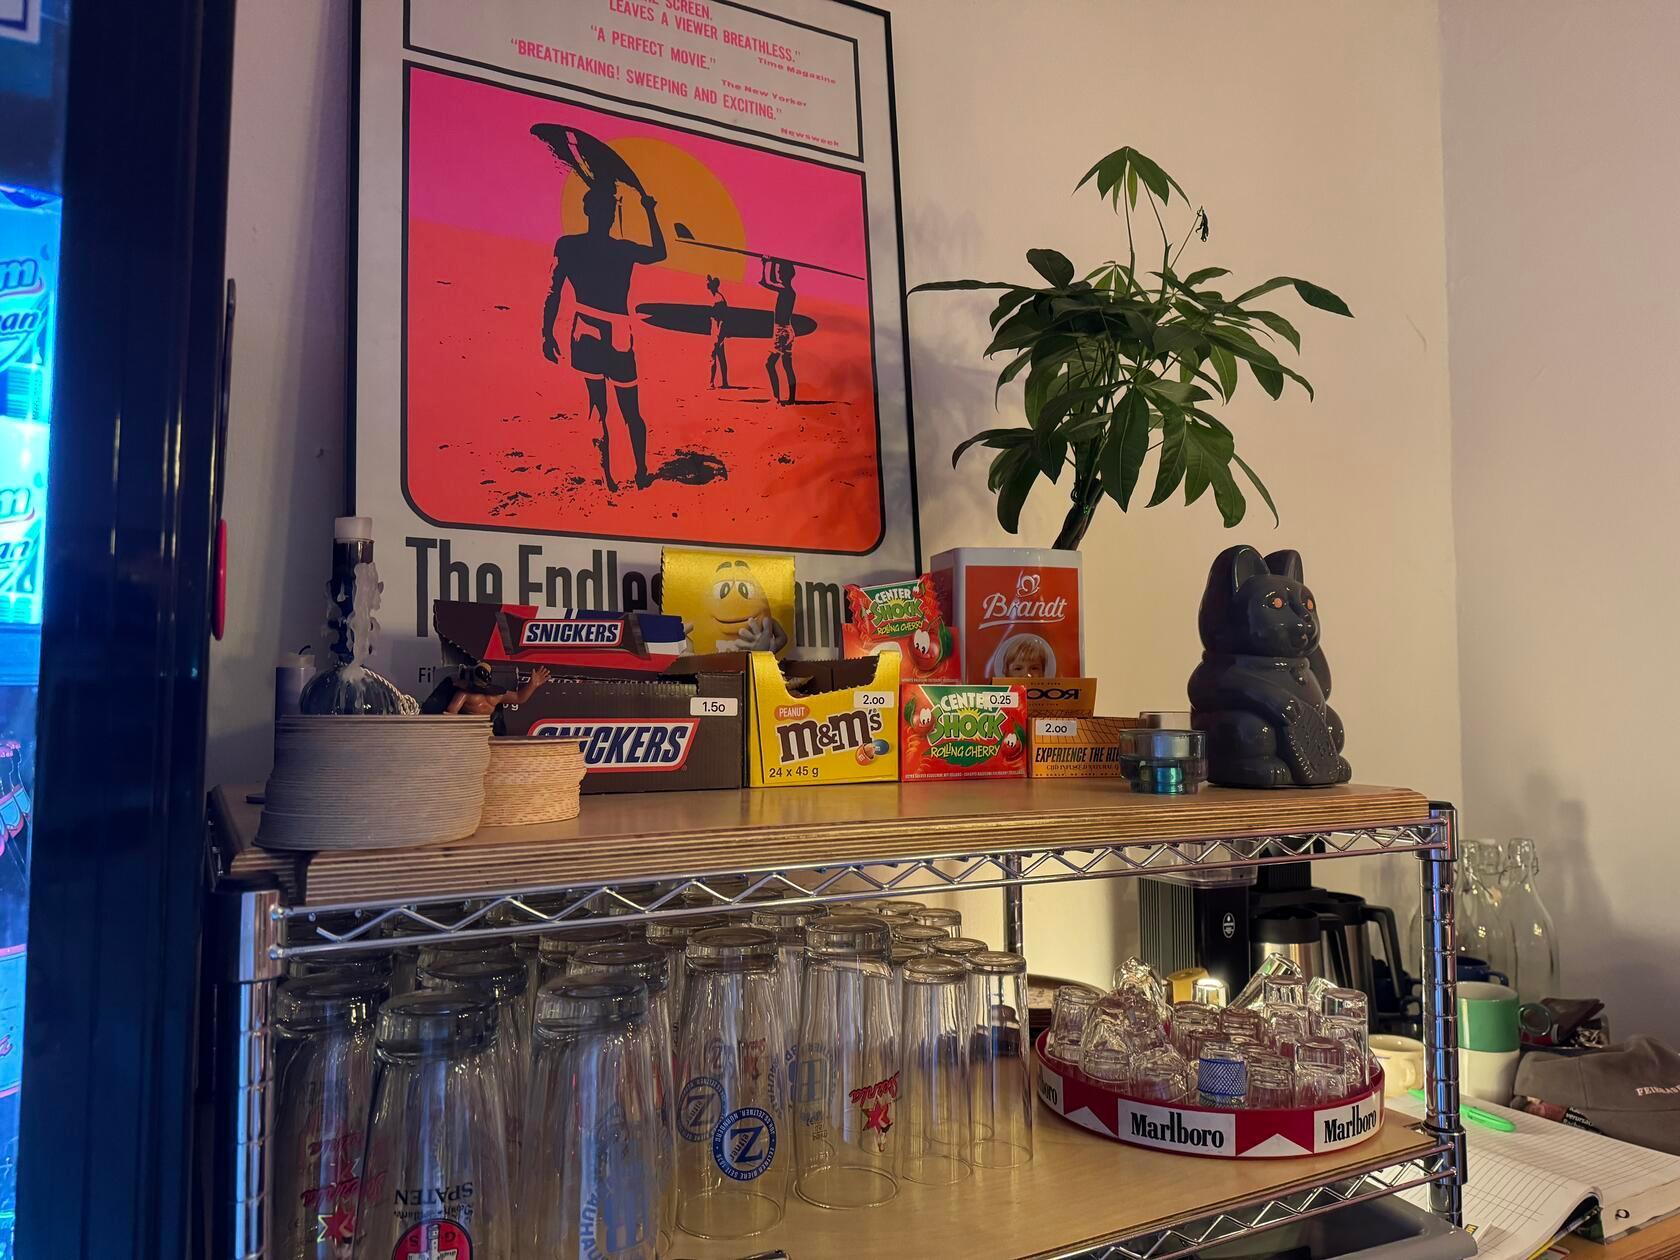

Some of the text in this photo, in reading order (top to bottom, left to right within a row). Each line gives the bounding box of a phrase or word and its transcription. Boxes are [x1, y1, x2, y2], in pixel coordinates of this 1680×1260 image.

[609, 0, 655, 22] LEAVES
[661, 12, 669, 26] A
[675, 15, 718, 40] VIEWER
[612, 30, 664, 57] PERFECT
[670, 47, 716, 70] MOVIE."
[758, 57, 836, 84] Time Magazine
[626, 68, 688, 97] SWEEPING
[694, 85, 717, 104] AND
[723, 94, 782, 120] EXCITING."
[722, 79, 807, 107] The New Yorker
[781, 127, 839, 147] Newsweek
[405, 536, 501, 637] The
[875, 588, 911, 604] CENTER
[870, 599, 923, 627] SHOCK
[983, 592, 1068, 620] Brandt
[526, 623, 620, 643] SNICKERS
[877, 620, 924, 635] ROLLING CHERRY
[779, 706, 805, 719] PEANUT
[989, 694, 1012, 706] 0.25
[927, 704, 1009, 747] SHOCK
[931, 742, 1001, 758] ROLLING CHERRY
[1035, 747, 1087, 763] EXPERIENCE
[1089, 747, 1106, 762] THE
[769, 766, 819, 778] 24 x 45 g
[1130, 1111, 1224, 1148] Marlboro
[1324, 1105, 1377, 1144] Marlboro
[394, 1182, 474, 1206] SPATEN
